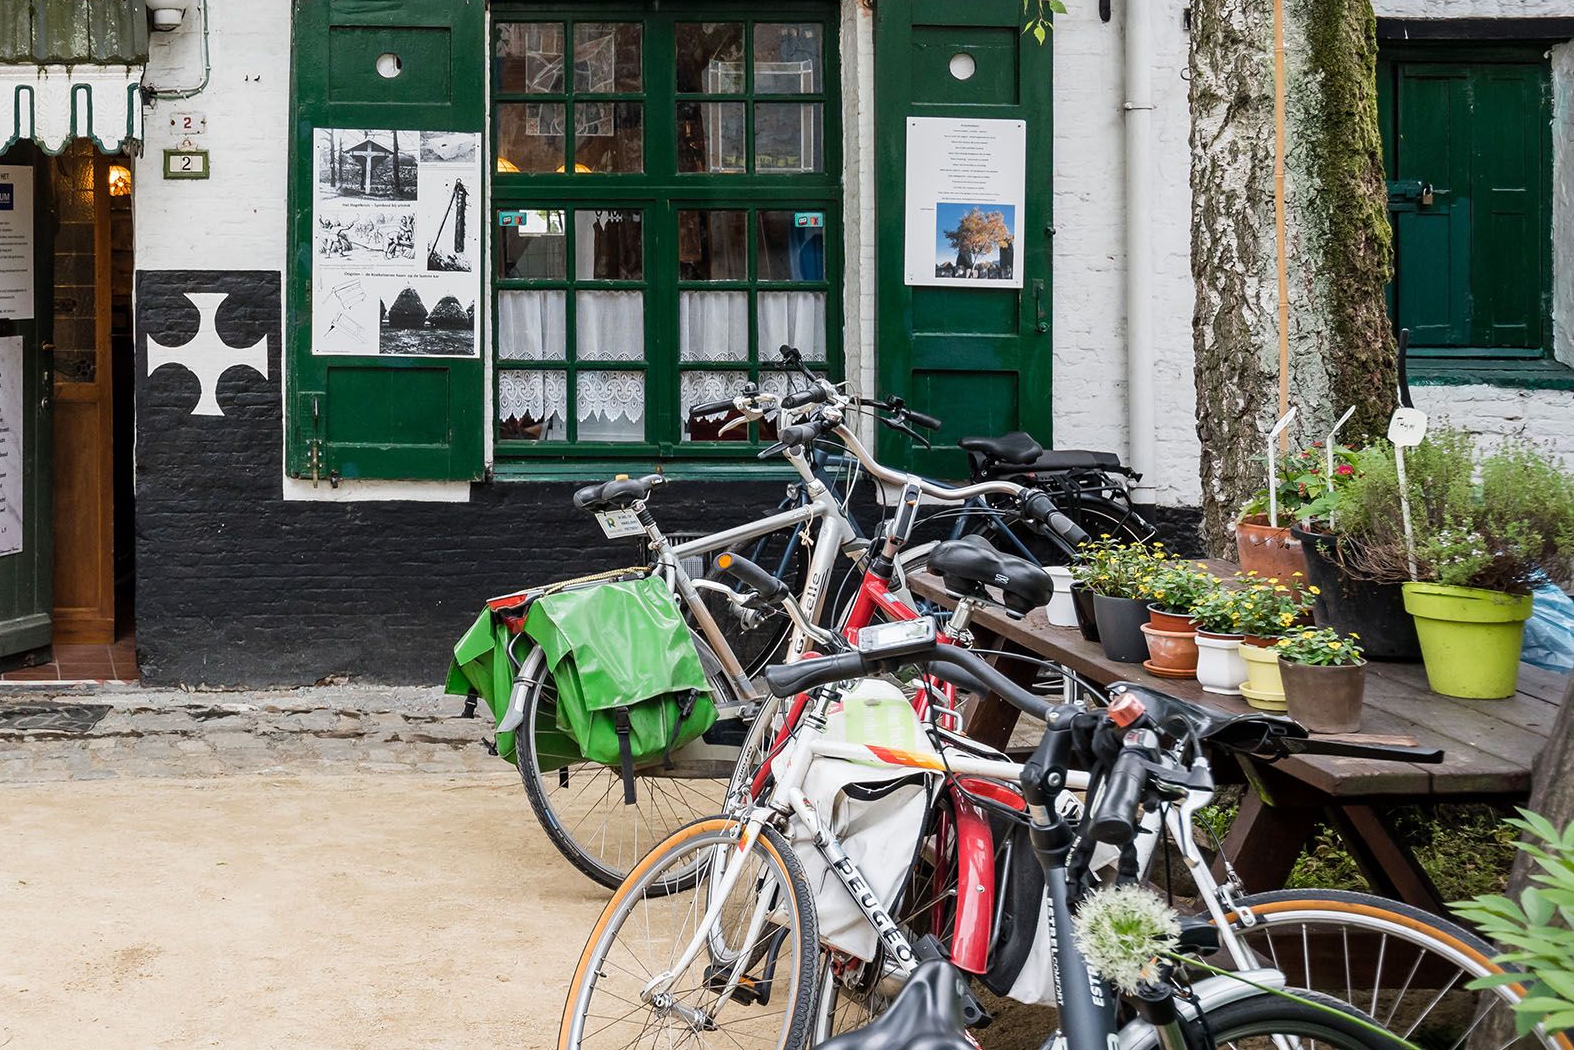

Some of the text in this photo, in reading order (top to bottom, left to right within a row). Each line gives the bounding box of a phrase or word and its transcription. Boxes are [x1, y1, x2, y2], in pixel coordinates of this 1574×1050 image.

[184, 117, 191, 128] 2
[182, 156, 191, 170] 2
[794, 572, 821, 654] Gzelle
[833, 857, 919, 965] PEUGEO
[1052, 956, 1064, 1006] COMFORT
